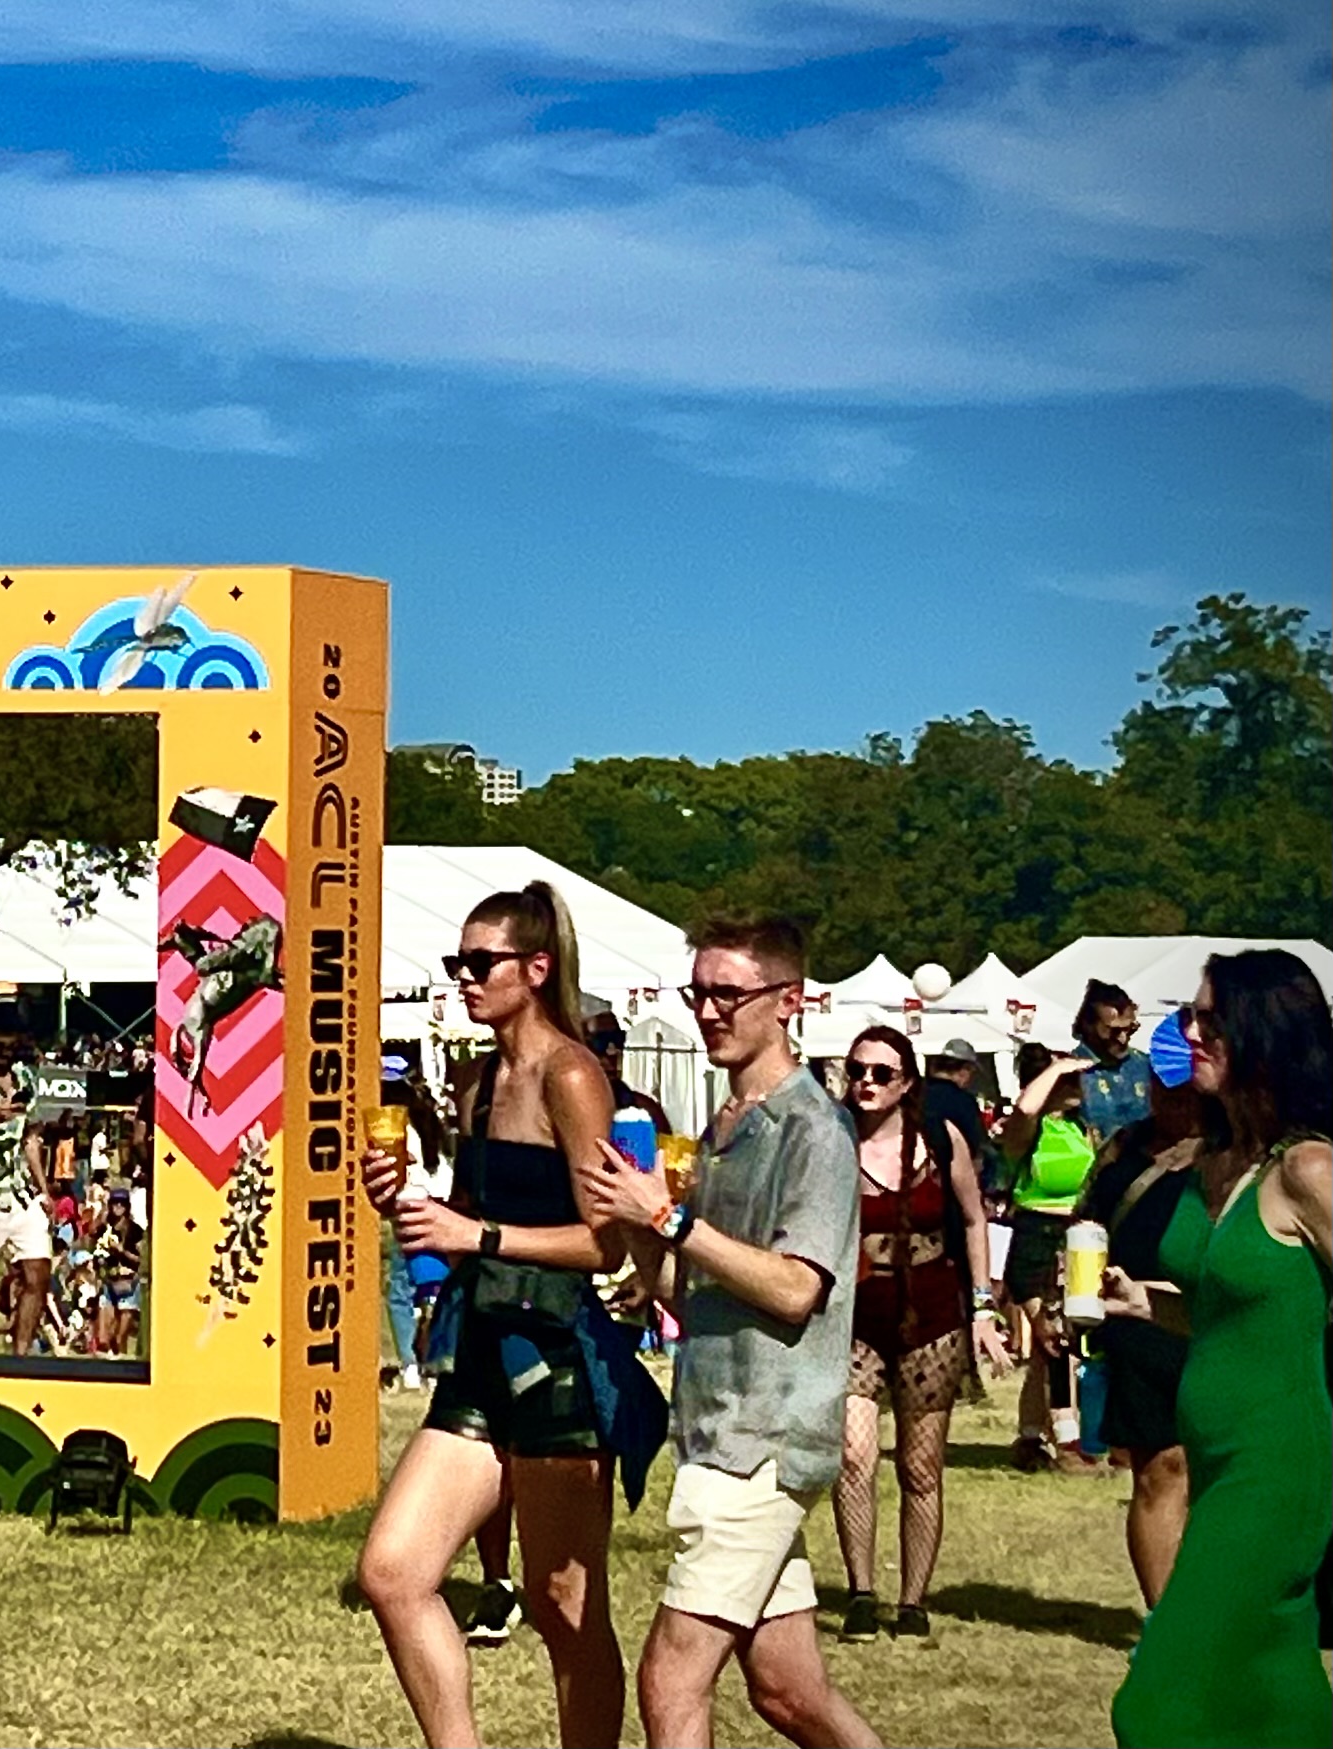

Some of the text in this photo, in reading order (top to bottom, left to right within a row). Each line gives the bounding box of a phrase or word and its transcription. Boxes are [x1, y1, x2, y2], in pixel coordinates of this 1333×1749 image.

[311, 711, 348, 909] ACL
[308, 929, 344, 1173] MUSIC
[306, 1198, 342, 1373] FEST
[314, 1389, 332, 1447] 23
